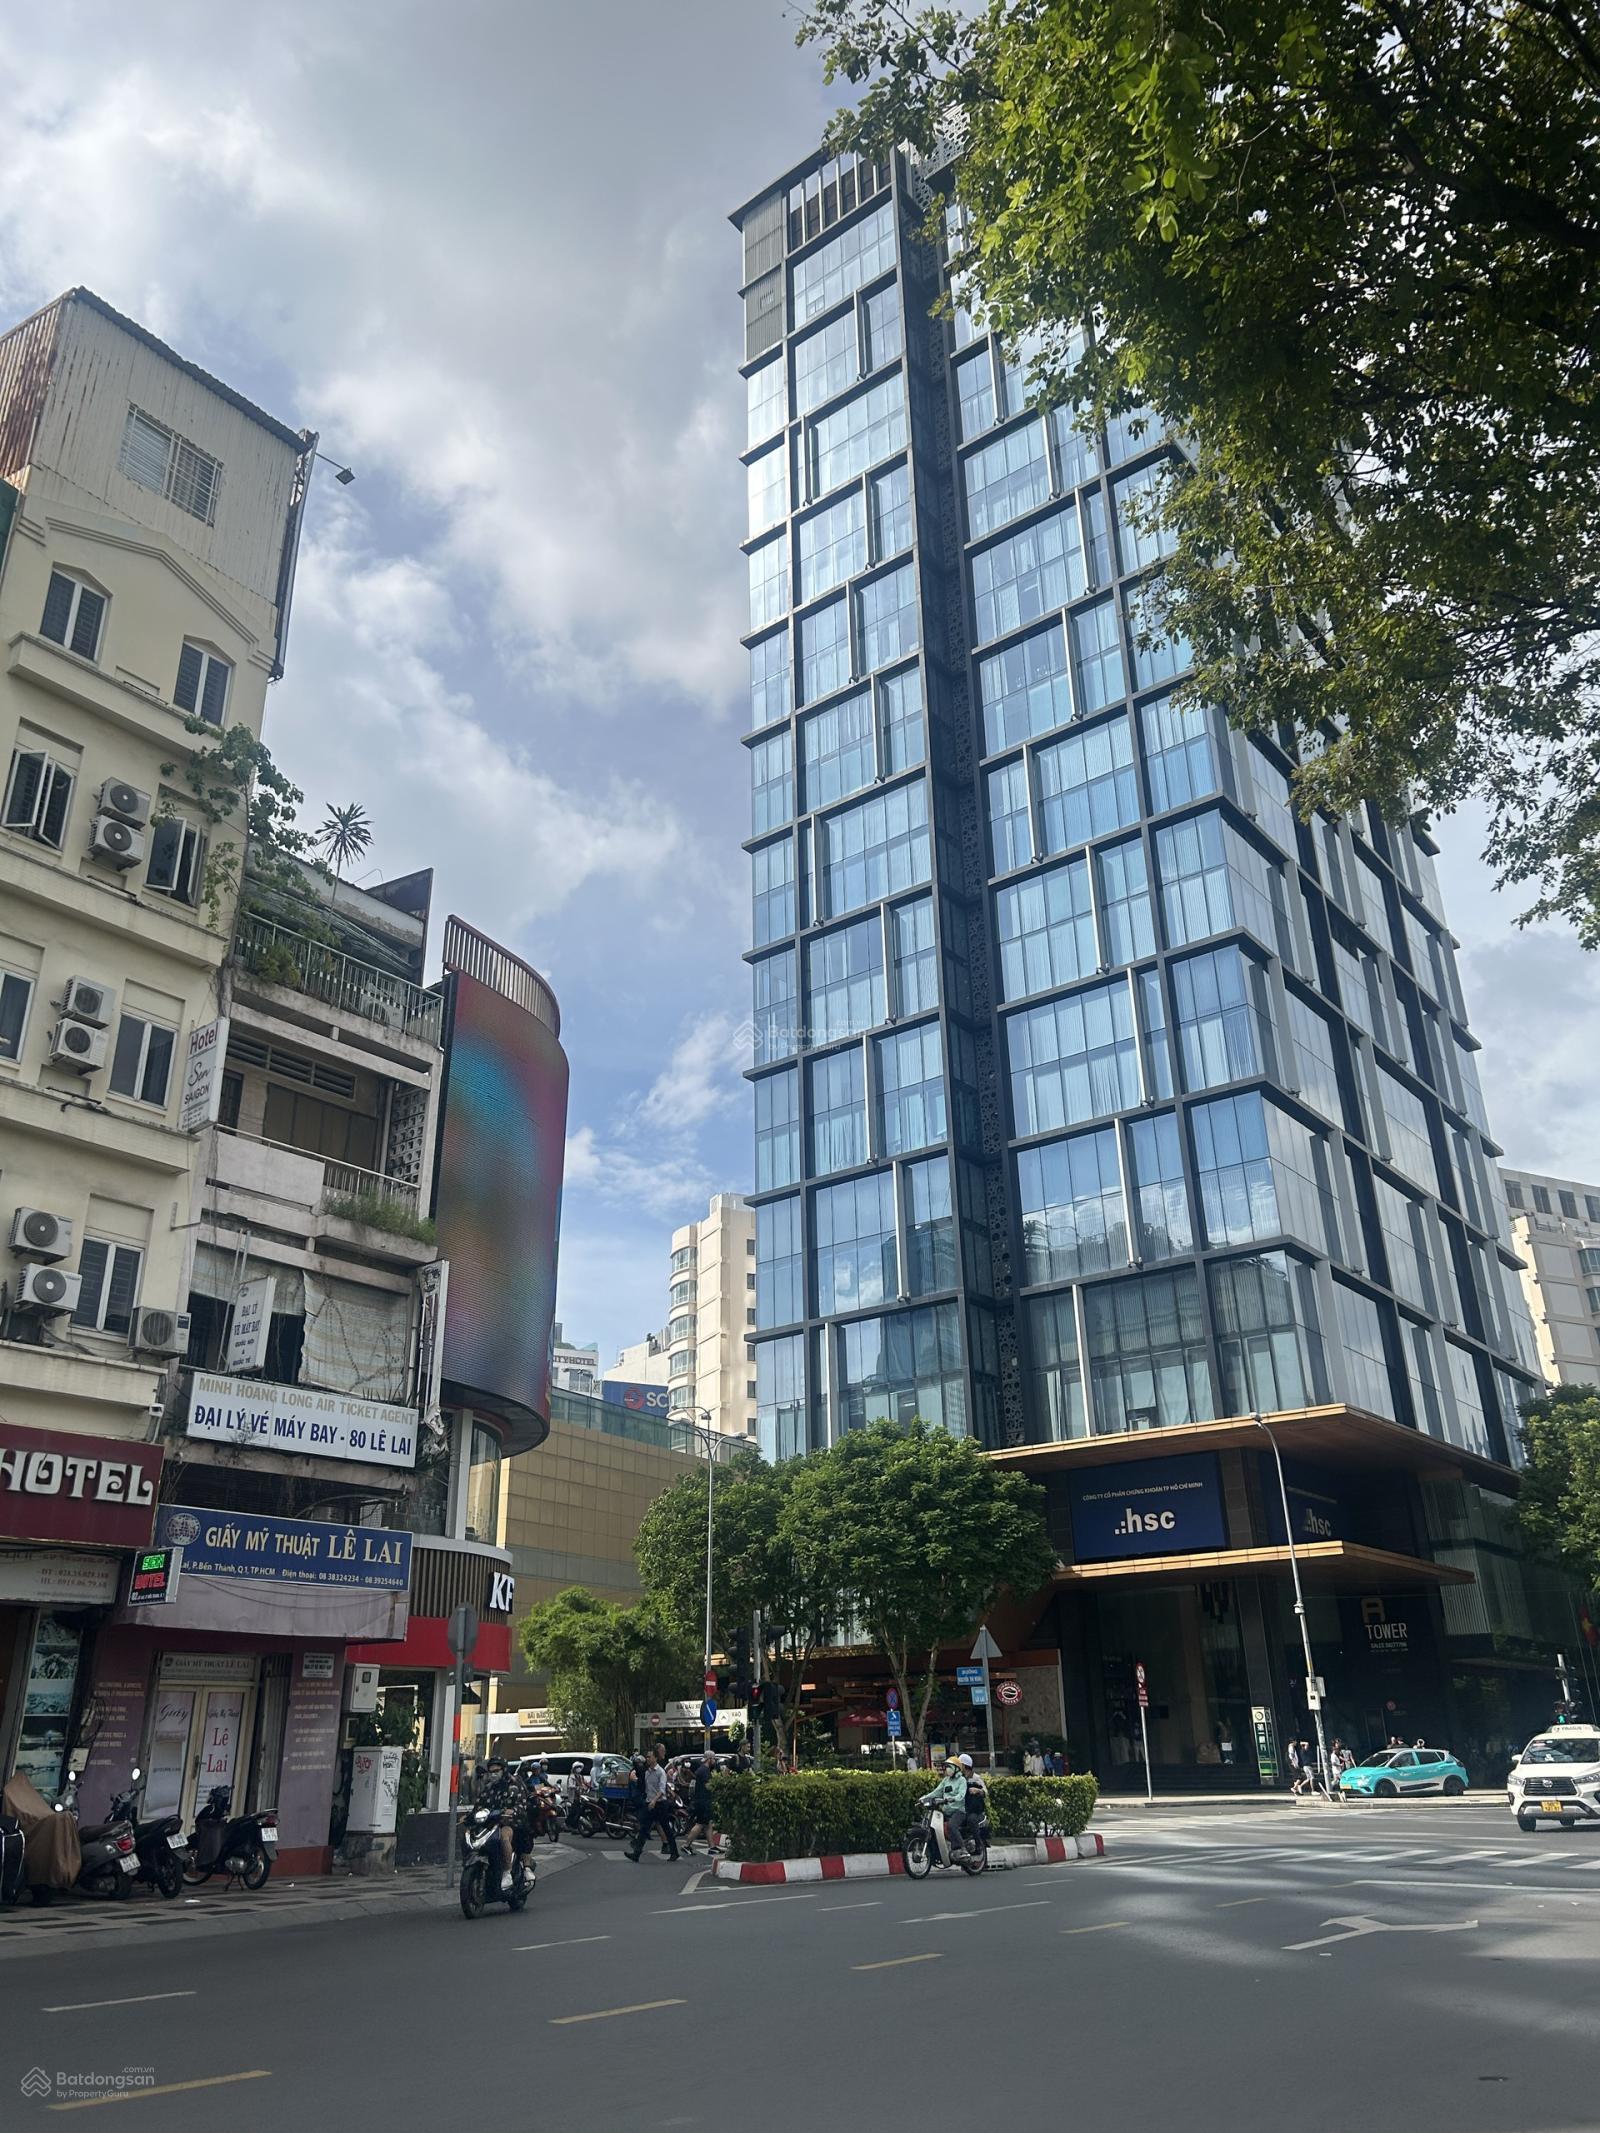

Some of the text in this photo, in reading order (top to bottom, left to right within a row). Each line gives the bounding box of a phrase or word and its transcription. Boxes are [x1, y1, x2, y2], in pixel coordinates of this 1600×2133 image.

[190, 1022, 219, 1055] Hotel
[184, 1082, 210, 1105] SAIGON
[198, 1377, 415, 1426] MINH HOANG LONG AIR TICKET AGENT
[194, 1405, 222, 1430] ĐẠI
[226, 1407, 246, 1431] LÝ
[249, 1410, 270, 1434] VÉ
[273, 1414, 306, 1440] MÁY
[310, 1423, 338, 1444] BAY
[349, 1429, 366, 1449] 80
[370, 1429, 387, 1451] LÊ
[391, 1436, 411, 1456] LAI
[0, 1447, 154, 1505] HOTEL
[1104, 1491, 1111, 1499] CỔ
[1112, 1489, 1126, 1498] PHẦN
[1126, 1487, 1144, 1496] CHỨNG
[1144, 1486, 1163, 1495] KHOÁN
[1170, 1482, 1178, 1491] HỒ
[1179, 1481, 1188, 1490] CHÍ
[1188, 1482, 1203, 1490] MINH
[205, 1521, 404, 1565] GIẤY MỸ THUẬT LÊ LAI
[281, 1568, 298, 1579] Điện
[1364, 1622, 1408, 1640] TOWER
[207, 1753, 228, 1773] Lai
